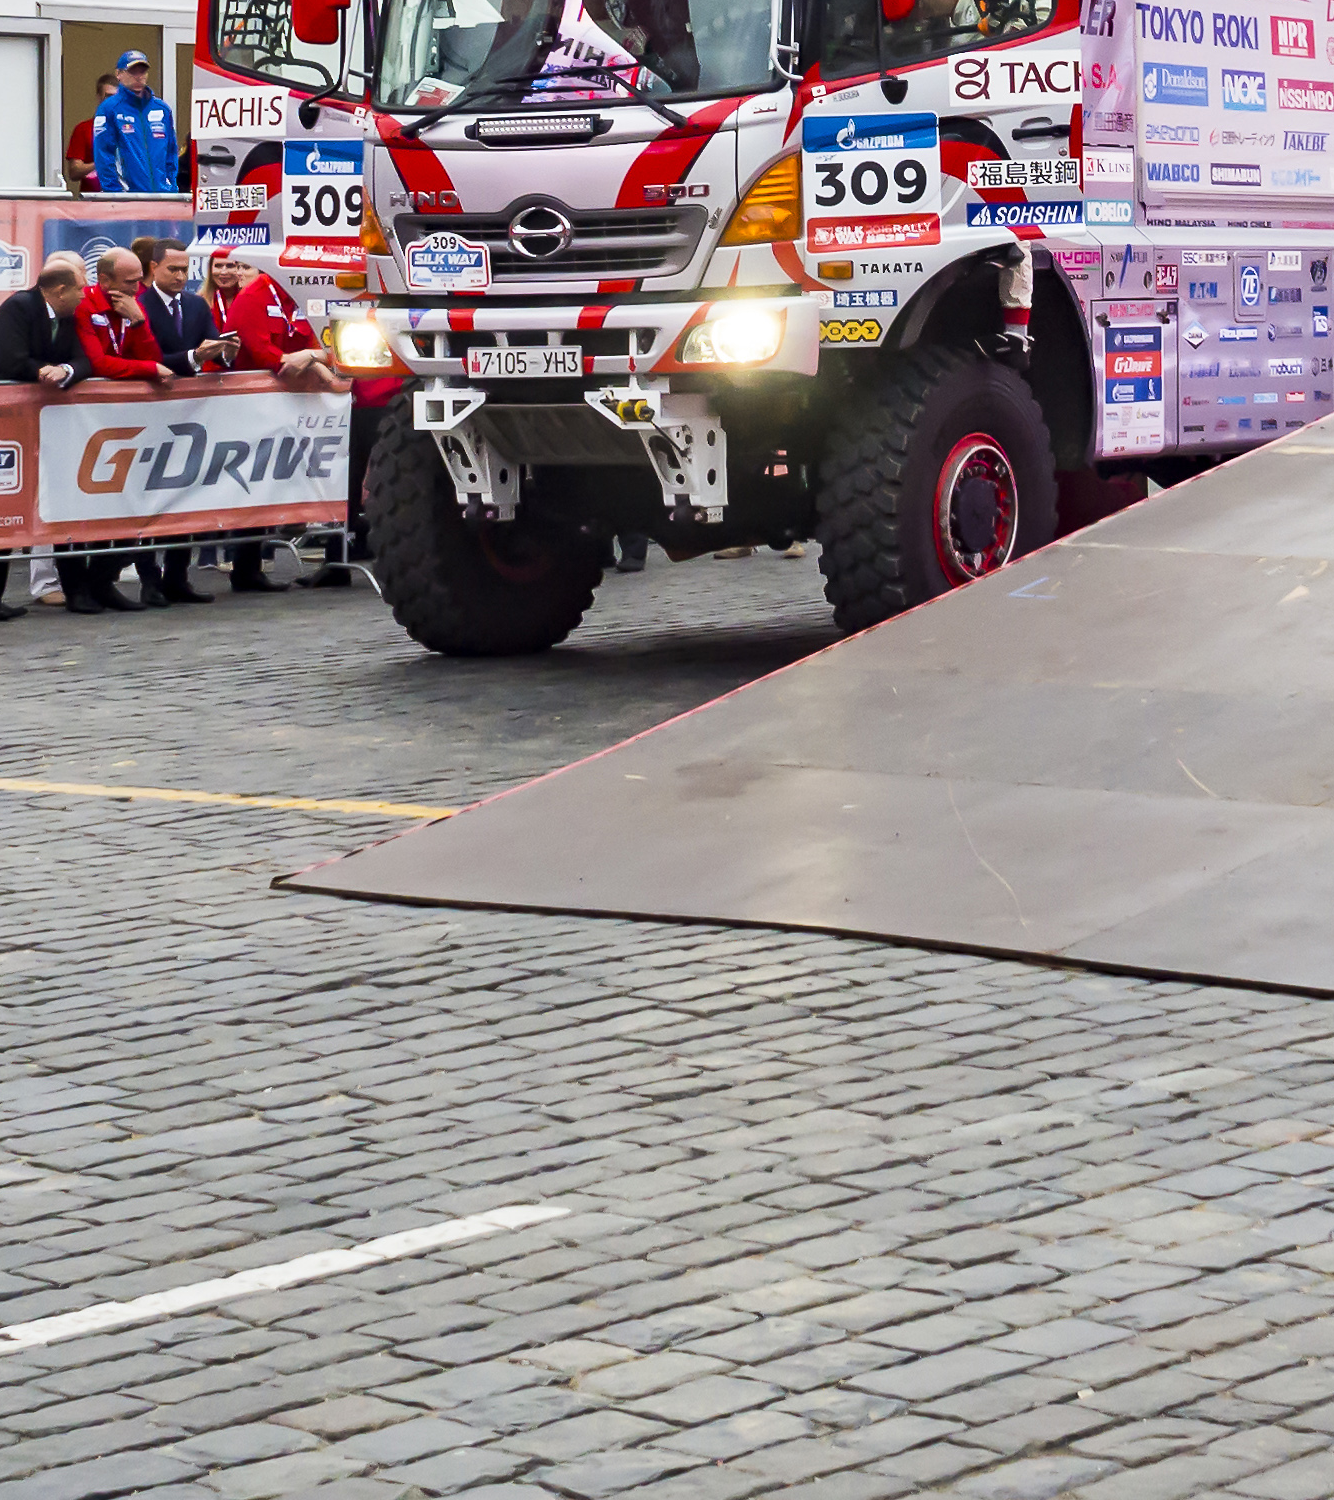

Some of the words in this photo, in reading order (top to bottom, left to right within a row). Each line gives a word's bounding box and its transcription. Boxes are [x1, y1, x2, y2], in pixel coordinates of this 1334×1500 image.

[1136, 2, 1204, 45] TOKYO
[1213, 12, 1259, 50] ROKI
[1277, 19, 1309, 48] NPR
[1161, 68, 1207, 89] Donaldson
[1224, 74, 1265, 105] NOK
[195, 95, 283, 128] TACHI-S
[856, 134, 904, 149] GAZPROM
[1284, 130, 1330, 152] TAKEBE
[981, 160, 1079, 186] 福島製鋼
[1109, 162, 1131, 174] LINE
[1147, 162, 1200, 183] WABCO
[815, 159, 927, 207] 309
[290, 184, 363, 227] 309
[390, 190, 458, 208] HINO
[995, 204, 1078, 225] SOHSHIN
[1086, 201, 1132, 222] KOBELCO
[835, 225, 864, 235] SILK
[893, 221, 931, 233] RALLY
[1147, 219, 1171, 227] HINO
[1174, 219, 1216, 228] MALAYSIA
[213, 227, 267, 245] SOHSHIN
[432, 236, 457, 250] 309
[414, 253, 446, 265] SILK
[448, 253, 479, 265] WAY
[860, 262, 924, 274] TAKATA
[289, 275, 334, 286] TAKATA
[482, 352, 527, 375] 7105
[297, 415, 348, 429] FUEL
